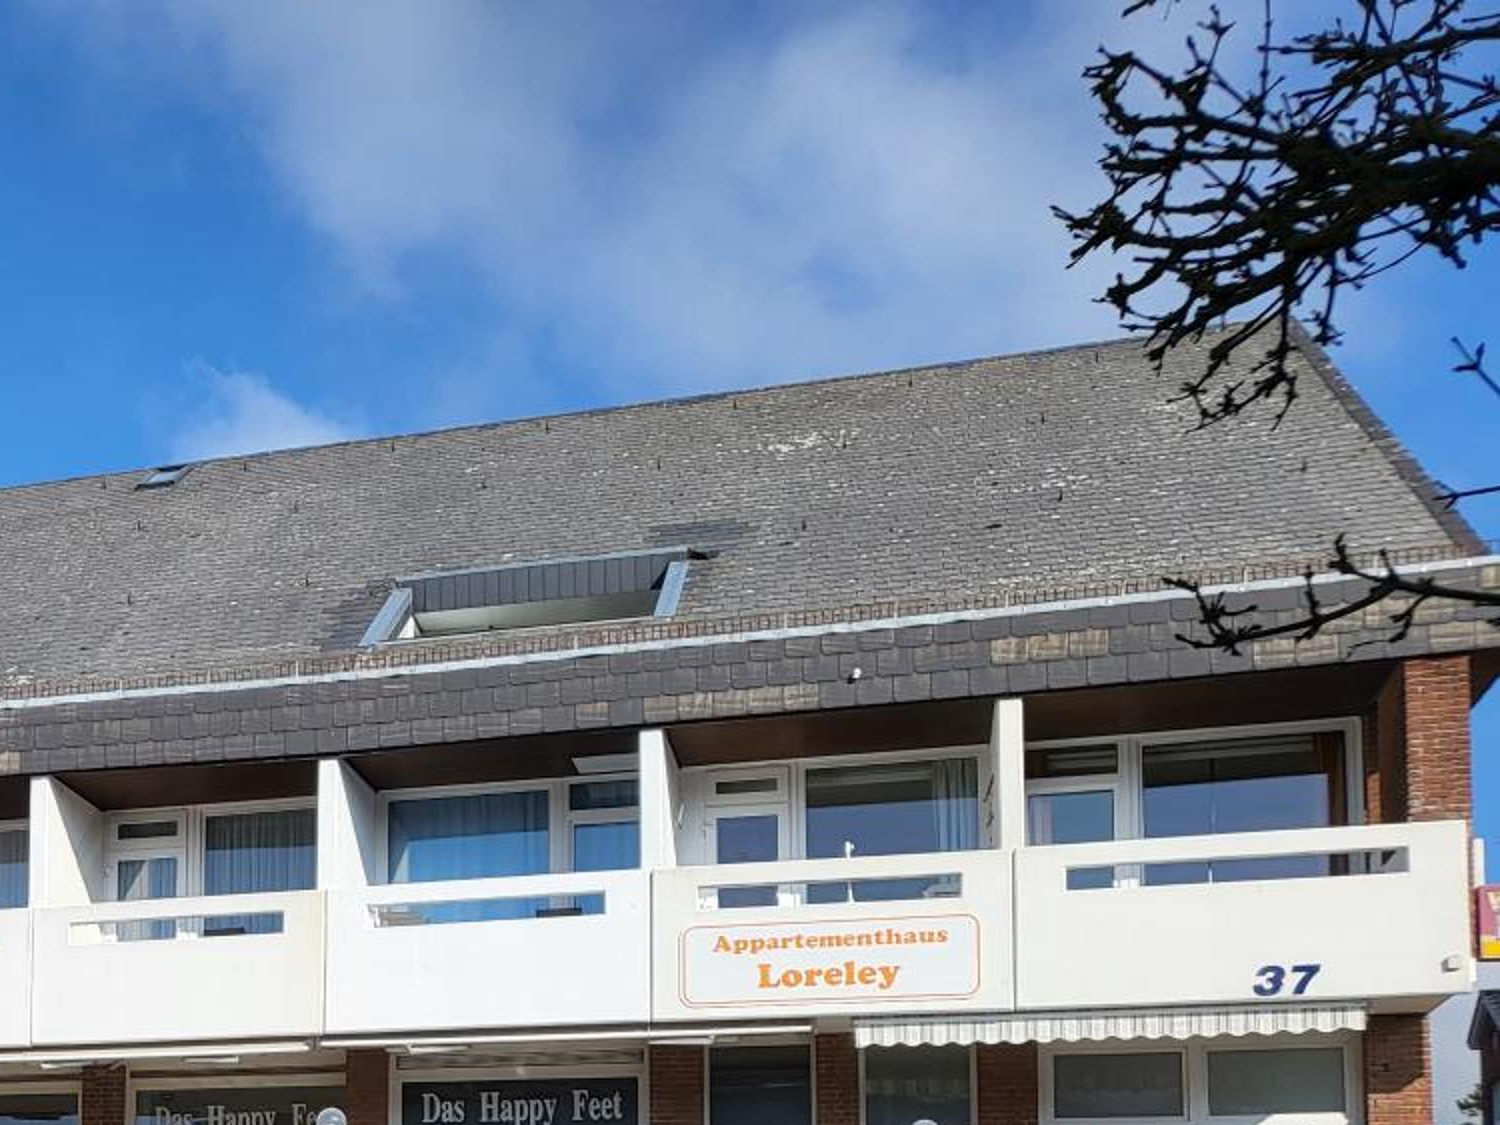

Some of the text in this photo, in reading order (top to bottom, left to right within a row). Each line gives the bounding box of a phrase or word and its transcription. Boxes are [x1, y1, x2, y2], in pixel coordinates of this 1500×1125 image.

[713, 928, 948, 954] Appartementhaus
[757, 961, 900, 989] Loreley
[1253, 964, 1321, 996] 37
[421, 1093, 465, 1123] Das
[572, 1089, 623, 1121] Feet
